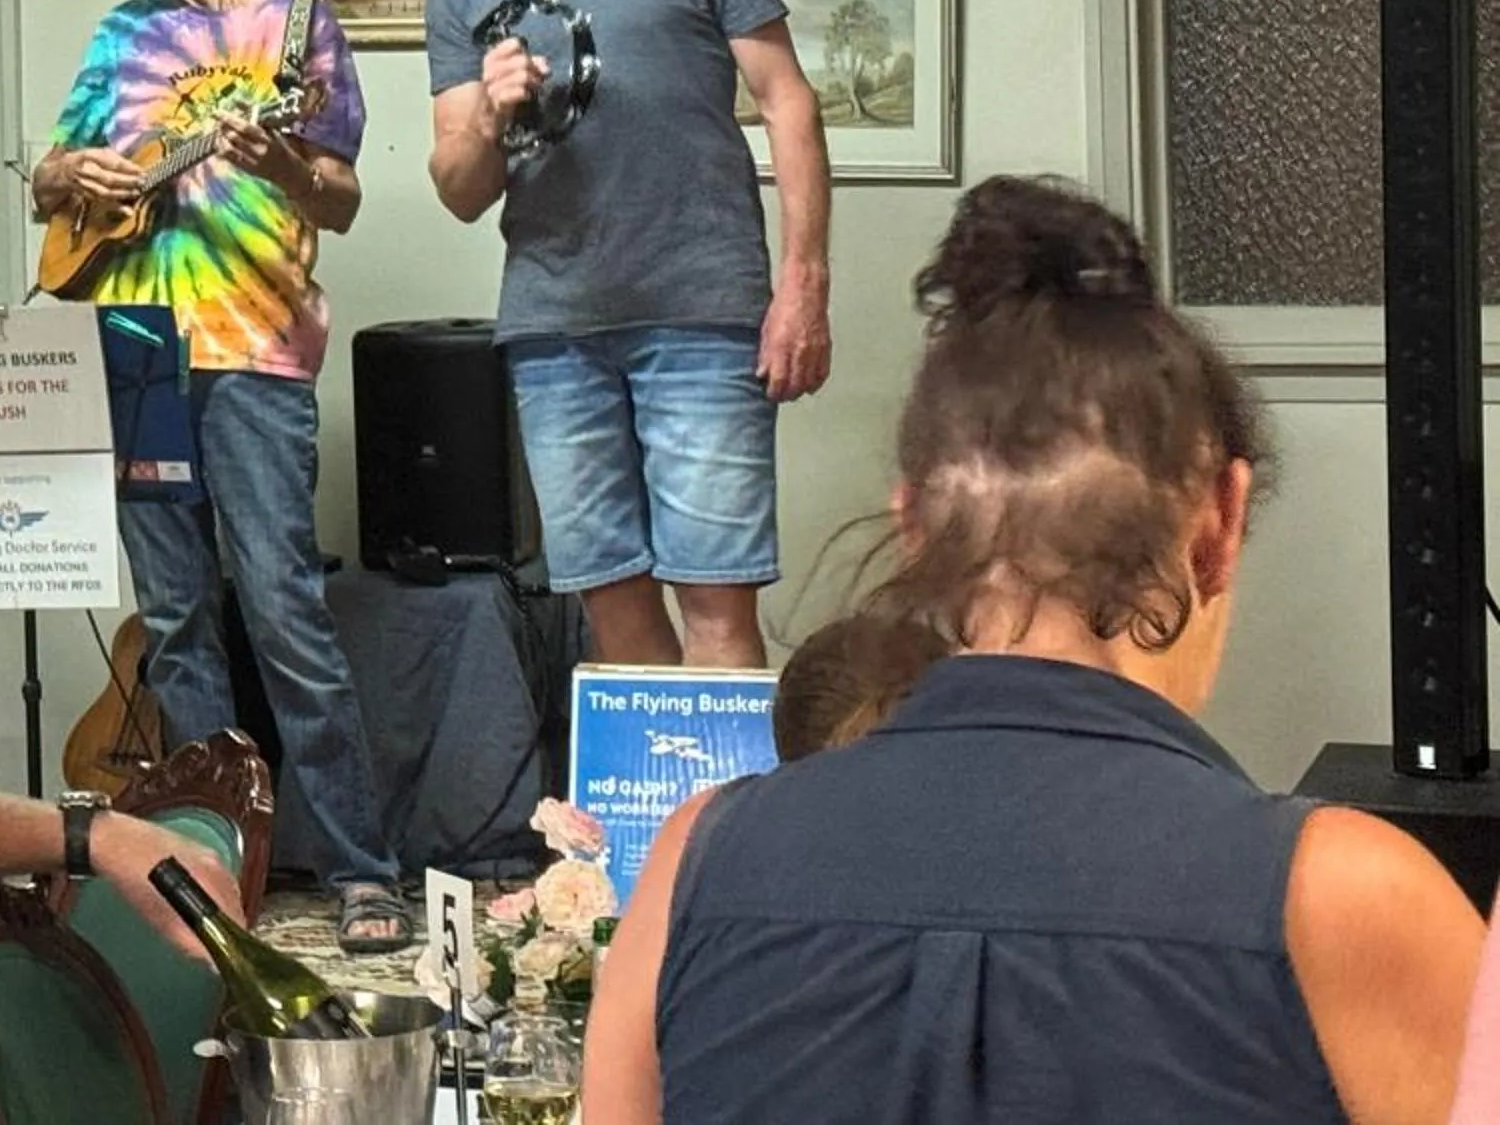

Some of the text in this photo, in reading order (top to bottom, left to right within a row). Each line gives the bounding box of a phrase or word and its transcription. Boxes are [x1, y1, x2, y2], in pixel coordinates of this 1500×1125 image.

[11, 351, 77, 367] BUSKERS
[8, 379, 37, 394] FOR
[42, 378, 69, 393] THE
[5, 540, 49, 554] Doctor
[51, 539, 97, 553] Service
[19, 561, 88, 574] DONATIONS
[28, 580, 43, 592] TO
[46, 579, 68, 592] THE
[587, 691, 774, 716] The Flying Busker
[587, 777, 616, 796] NO
[443, 892, 459, 969] 5
